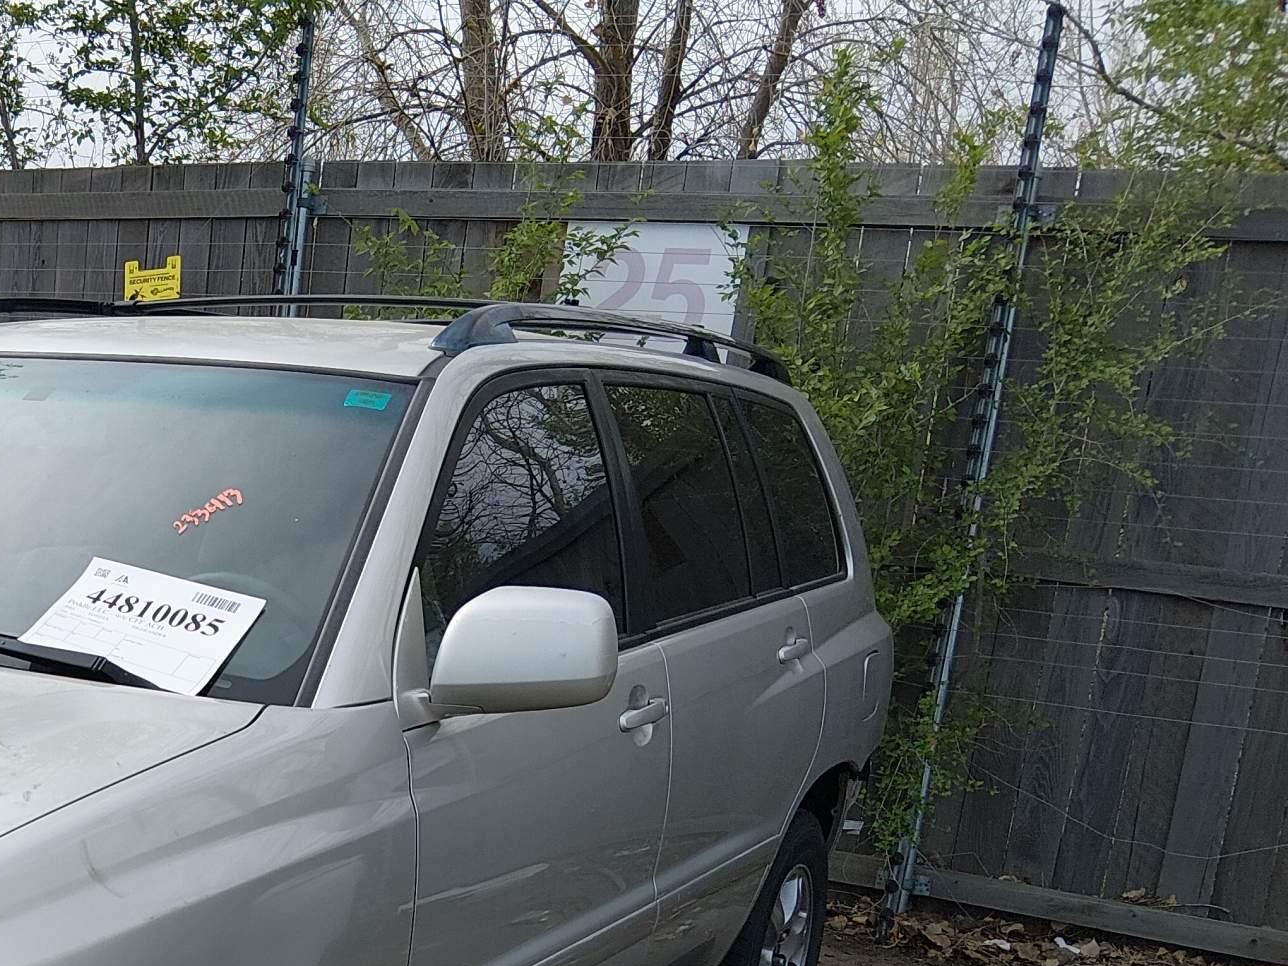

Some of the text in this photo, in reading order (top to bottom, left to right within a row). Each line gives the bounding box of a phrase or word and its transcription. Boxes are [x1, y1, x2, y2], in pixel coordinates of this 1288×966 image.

[129, 276, 157, 285] SECURITY
[157, 274, 176, 282] FENCE
[592, 247, 712, 331] 25
[86, 588, 227, 637] 44810085
